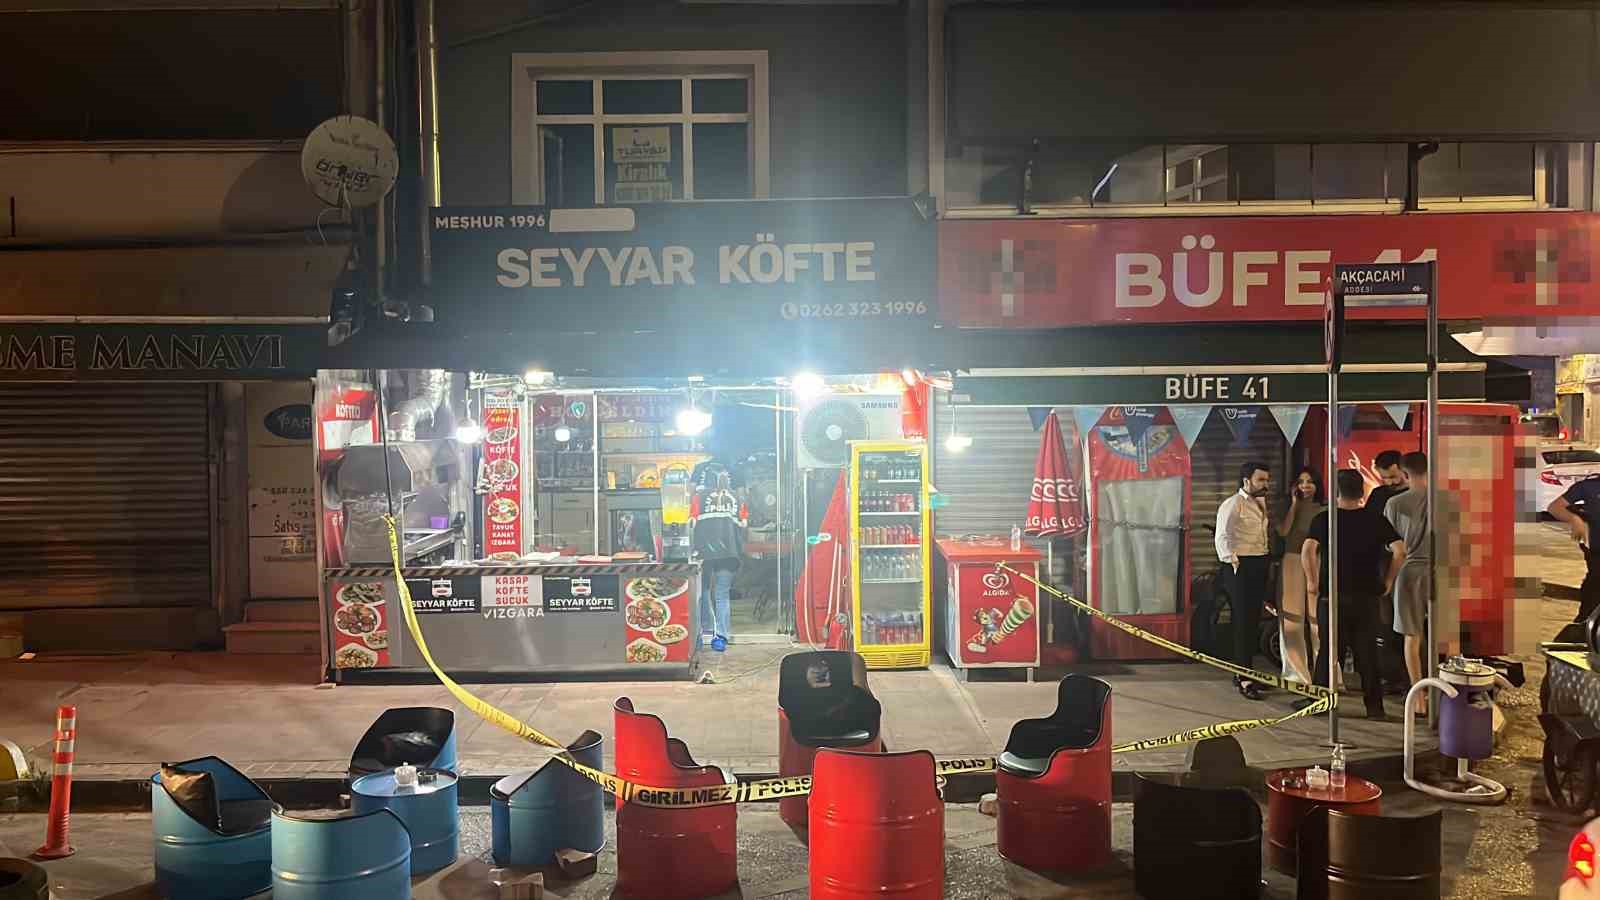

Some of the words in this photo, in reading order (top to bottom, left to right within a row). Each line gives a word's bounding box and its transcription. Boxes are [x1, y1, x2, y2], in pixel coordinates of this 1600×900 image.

[435, 215, 504, 230] MEŞHUR
[510, 214, 545, 228] 1996
[496, 246, 695, 288] SEYYAR
[719, 233, 876, 284] KÖFTE
[1115, 235, 1331, 308] BÜFE
[800, 302, 845, 317] 0262
[848, 301, 881, 316] 323
[884, 300, 927, 315] 1996
[1165, 373, 1229, 399] BÜFE
[1242, 376, 1268, 399] 41
[495, 576, 529, 585] KASAP
[411, 599, 446, 608] SEYYAR
[446, 598, 475, 607] KÖFTE
[549, 599, 585, 607] SEYYAR
[586, 597, 614, 606] KÖFTE
